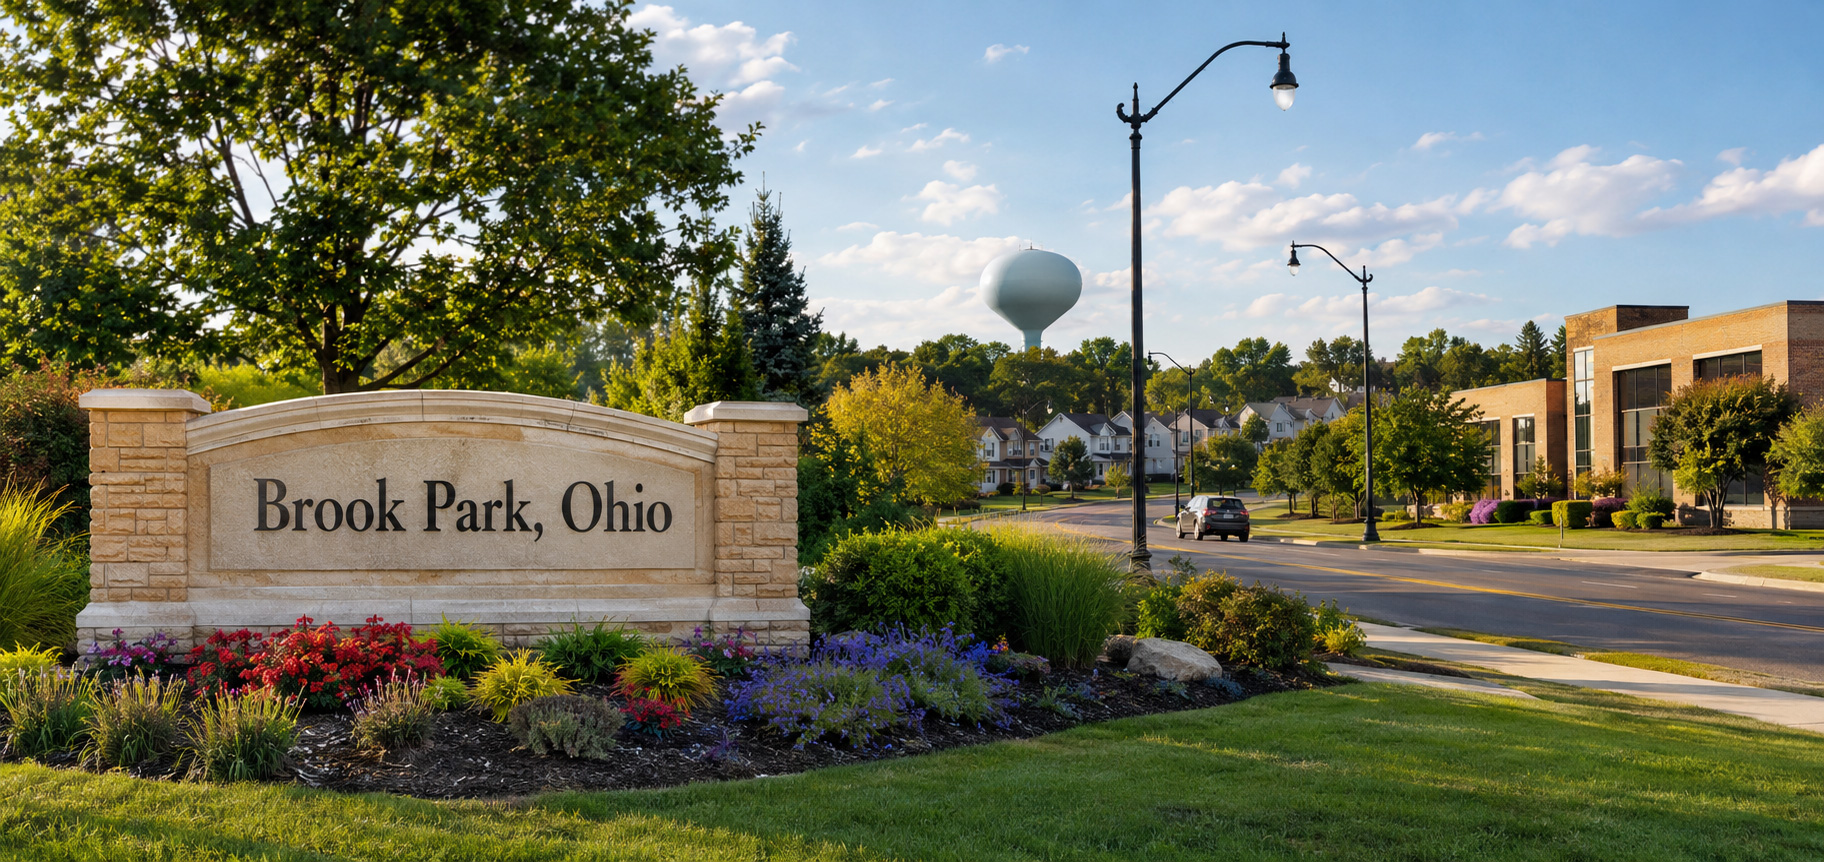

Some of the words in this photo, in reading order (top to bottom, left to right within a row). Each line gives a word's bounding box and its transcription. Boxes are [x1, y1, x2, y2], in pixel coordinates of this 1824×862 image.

[253, 477, 406, 532] Brook
[422, 479, 544, 543] Park,
[561, 479, 673, 533] Ohio
